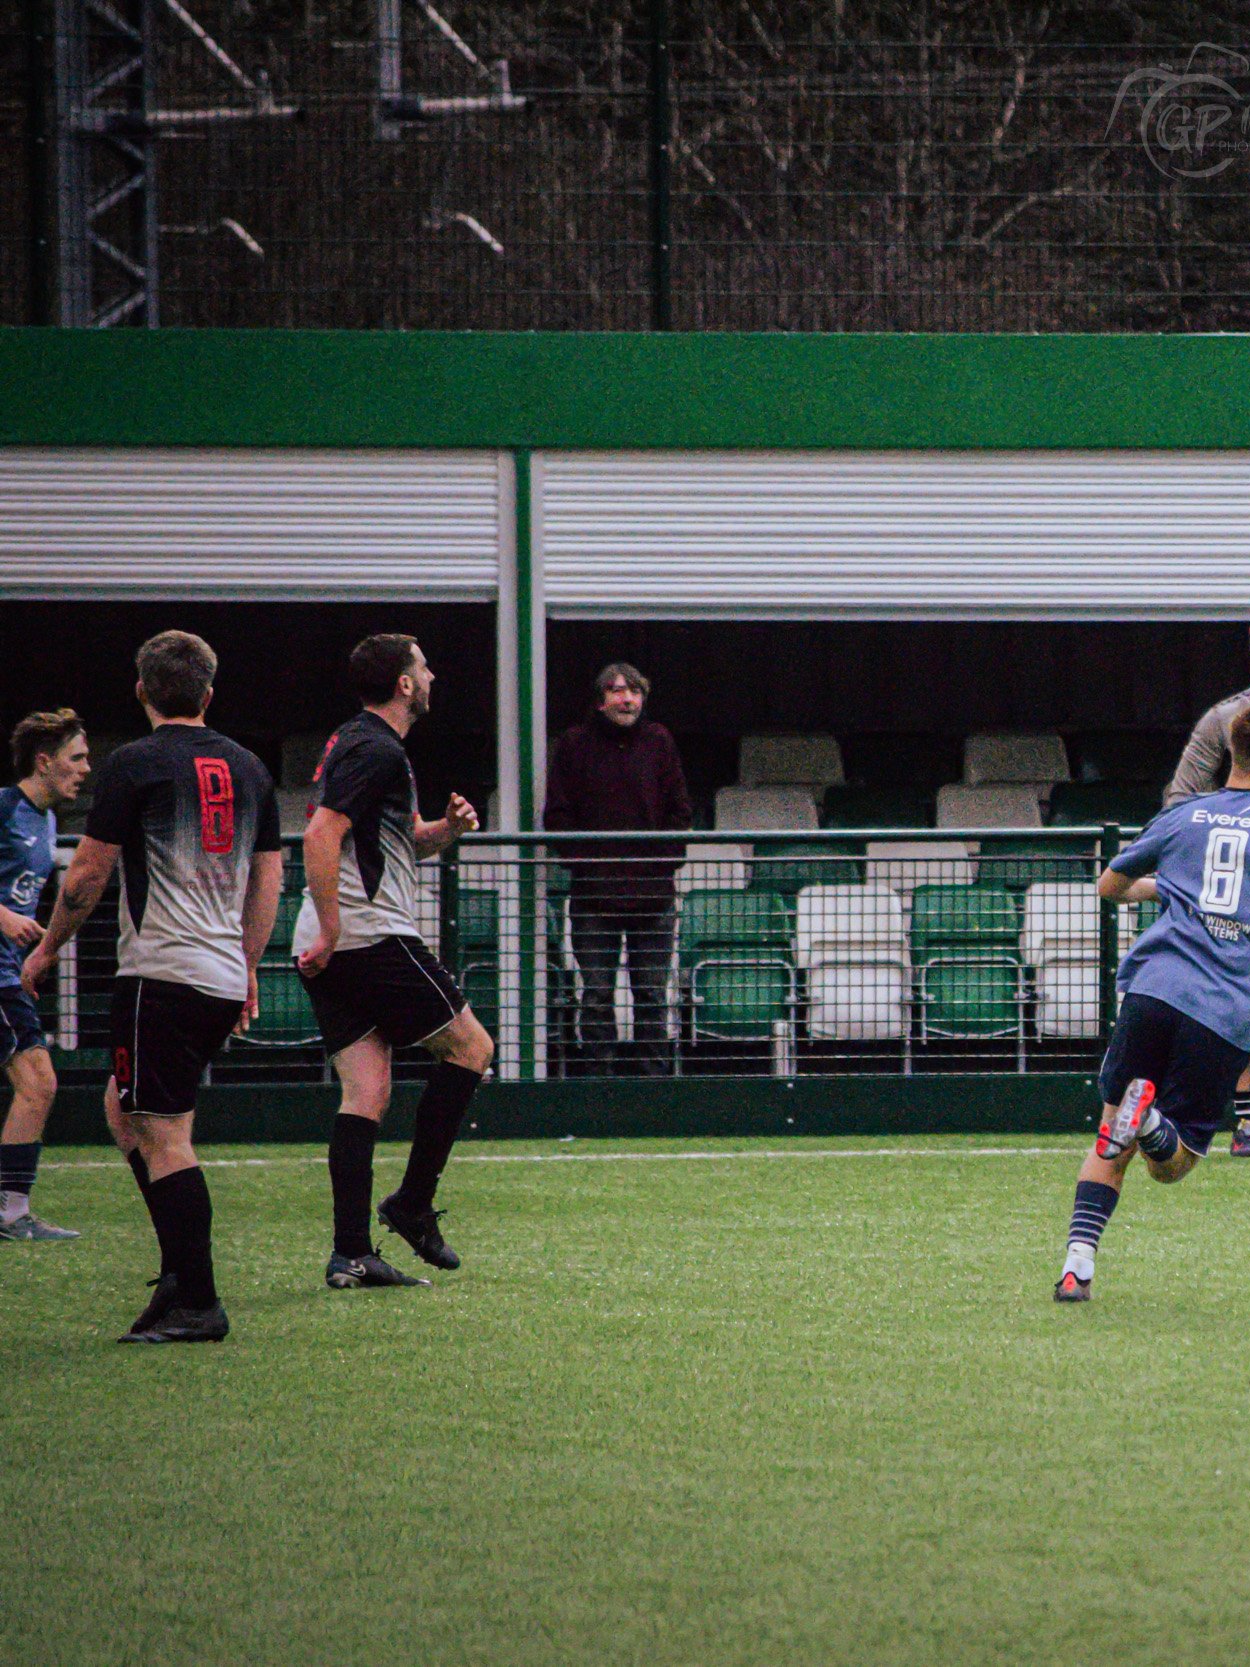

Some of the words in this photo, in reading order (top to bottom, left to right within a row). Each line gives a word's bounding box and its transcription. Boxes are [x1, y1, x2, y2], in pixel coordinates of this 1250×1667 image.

[194, 757, 234, 853] 8
[1200, 827, 1249, 915] 8
[1206, 924, 1240, 941] STEMS
